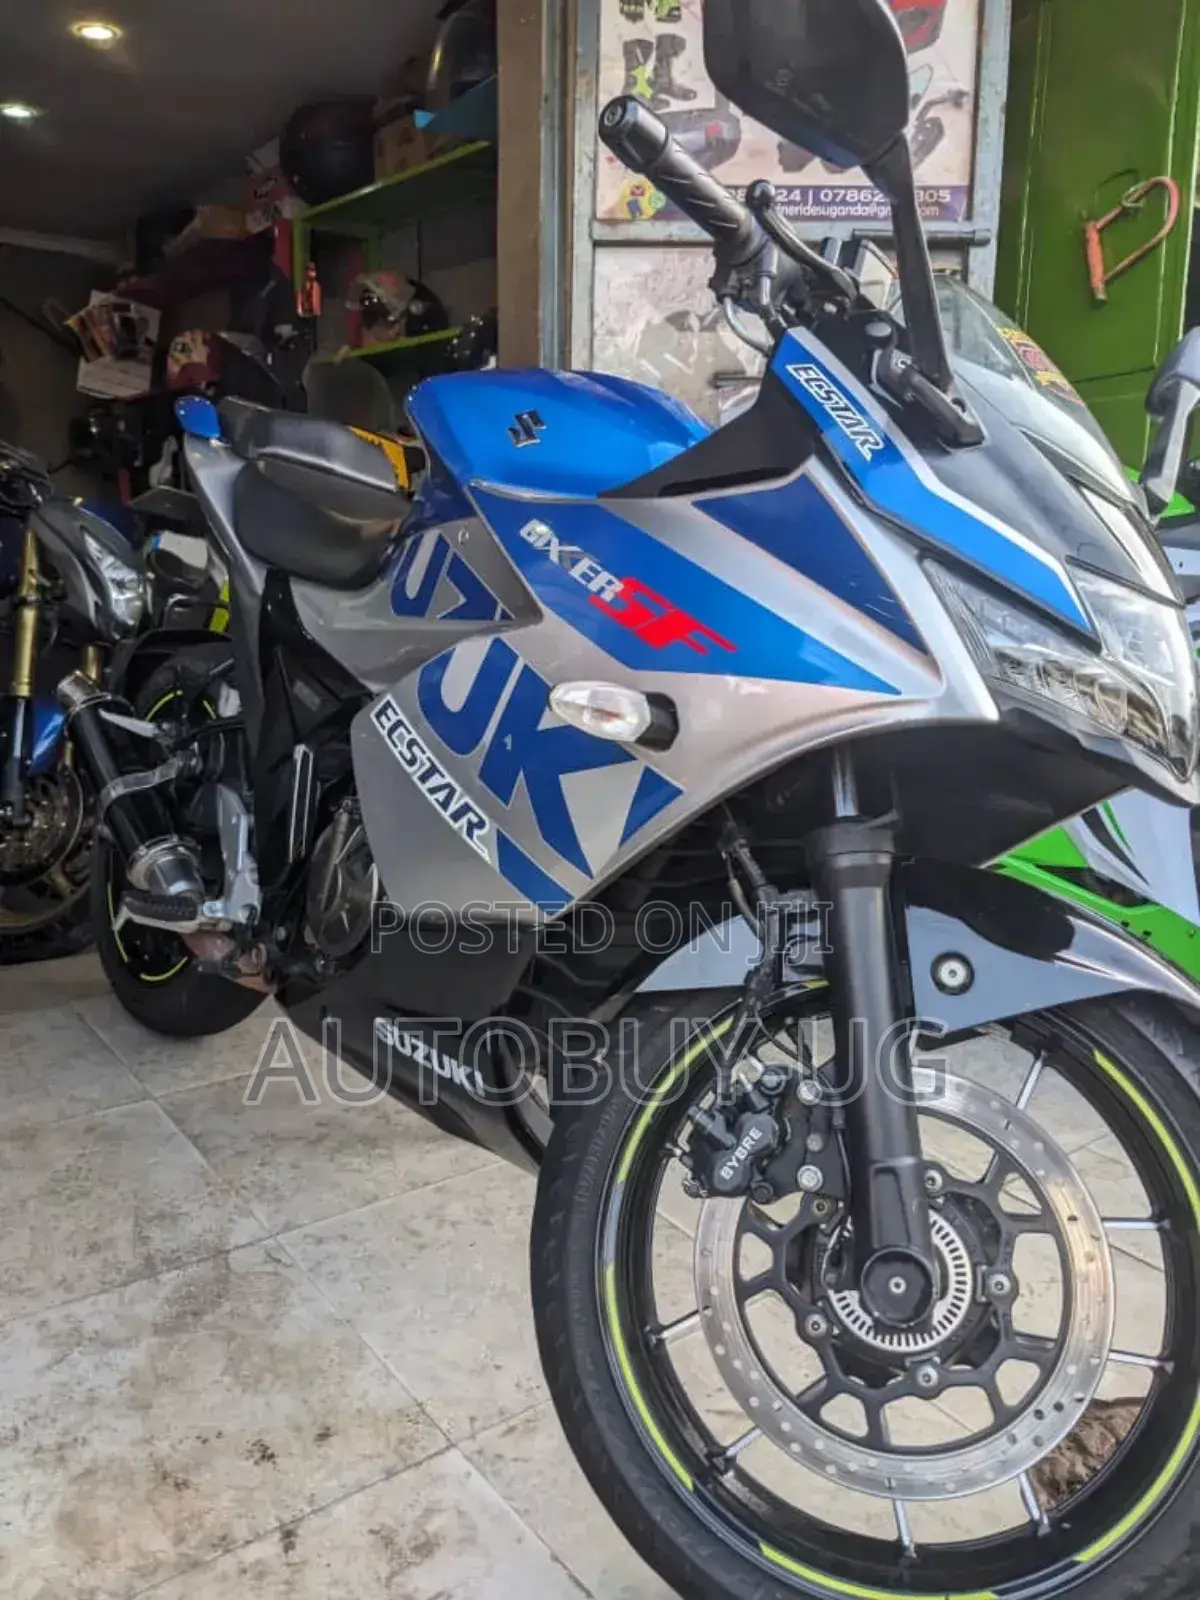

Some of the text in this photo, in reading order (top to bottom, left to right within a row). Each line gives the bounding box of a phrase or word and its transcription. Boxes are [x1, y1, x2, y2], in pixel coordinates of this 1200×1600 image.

[785, 364, 884, 462] ECSTAR
[589, 577, 737, 655] SF
[370, 693, 491, 864] ECSTAR
[375, 1017, 486, 1098] SUZUKI
[720, 1126, 763, 1180] BYBRE
